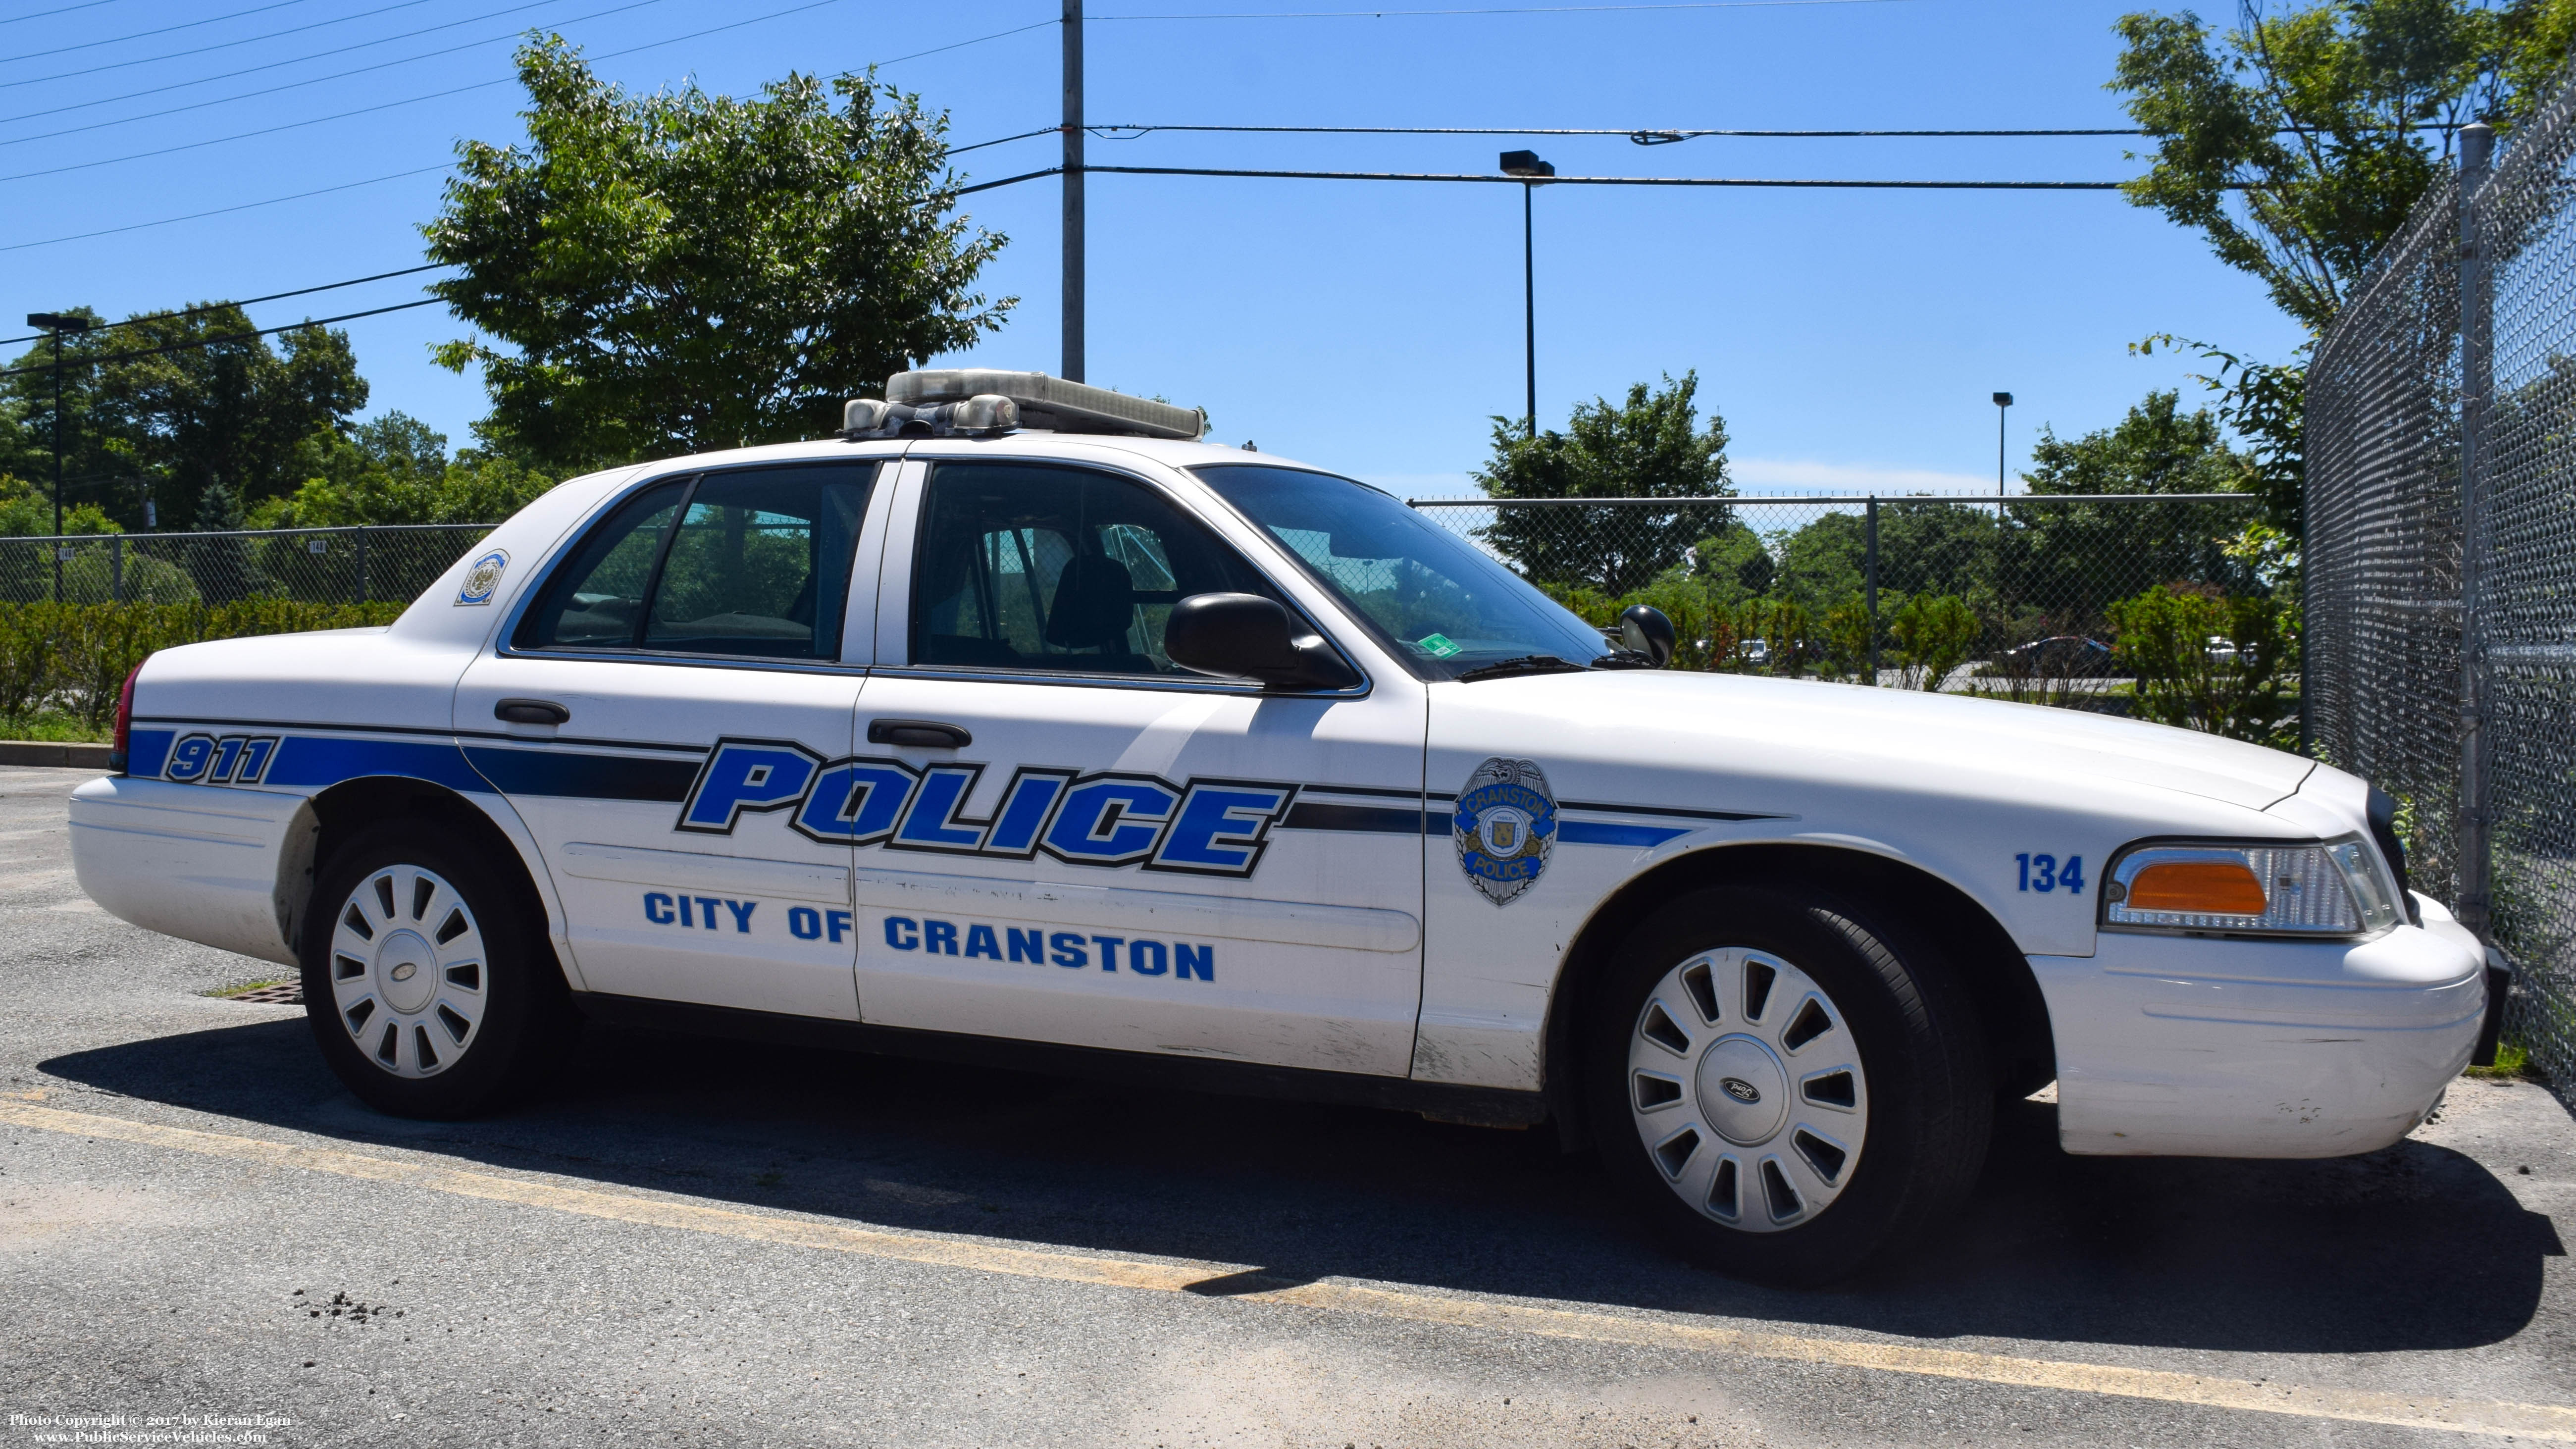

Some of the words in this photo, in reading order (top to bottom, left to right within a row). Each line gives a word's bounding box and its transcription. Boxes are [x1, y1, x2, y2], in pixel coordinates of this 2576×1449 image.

[165, 732, 281, 784] 911
[675, 737, 1301, 879] POLICE
[1466, 787, 1548, 816] CRANSTON
[1473, 857, 1530, 879] POLICE
[2015, 853, 2084, 894] 134
[644, 893, 755, 933] CITY
[788, 907, 851, 944] OF
[883, 916, 1214, 982] CRANSTON
[1731, 1083, 1752, 1098] Ford
